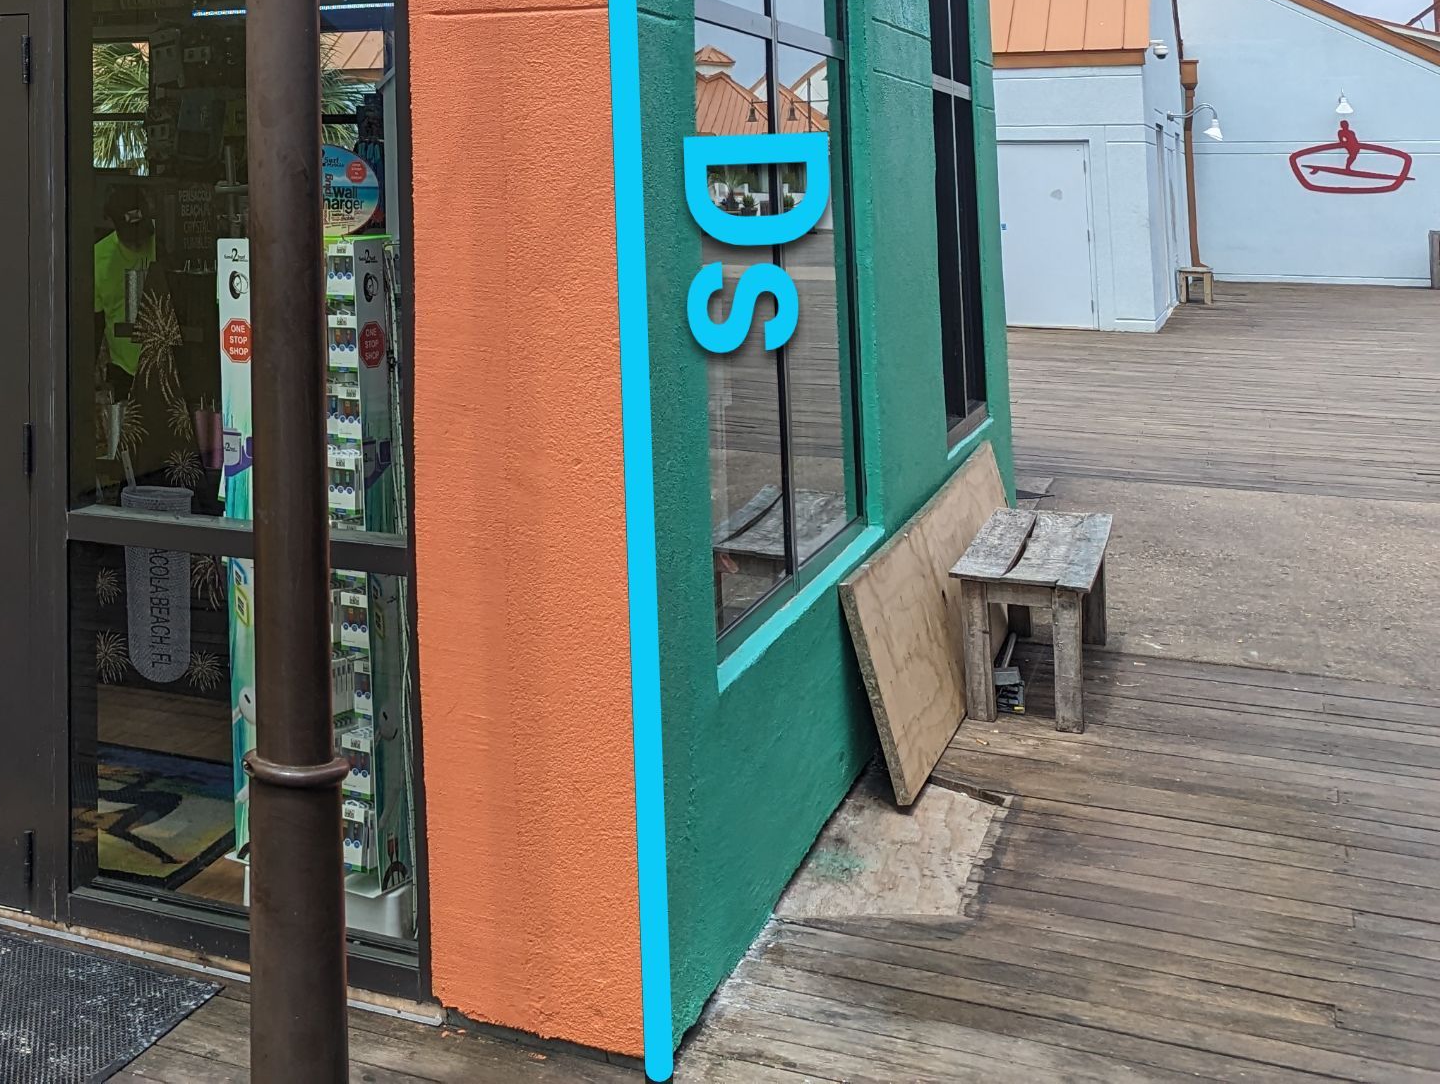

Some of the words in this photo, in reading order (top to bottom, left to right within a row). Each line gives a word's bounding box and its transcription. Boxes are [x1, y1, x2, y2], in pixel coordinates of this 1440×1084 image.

[332, 186, 358, 199] wall
[322, 194, 364, 214] harger
[230, 324, 246, 334] ONE
[365, 328, 377, 337] ONE
[229, 335, 248, 345] STOP
[364, 339, 379, 349] STOP
[229, 347, 249, 356] SHOP
[364, 351, 380, 361] SHOP
[149, 548, 170, 593] ACOLA
[152, 653, 172, 668] FL
